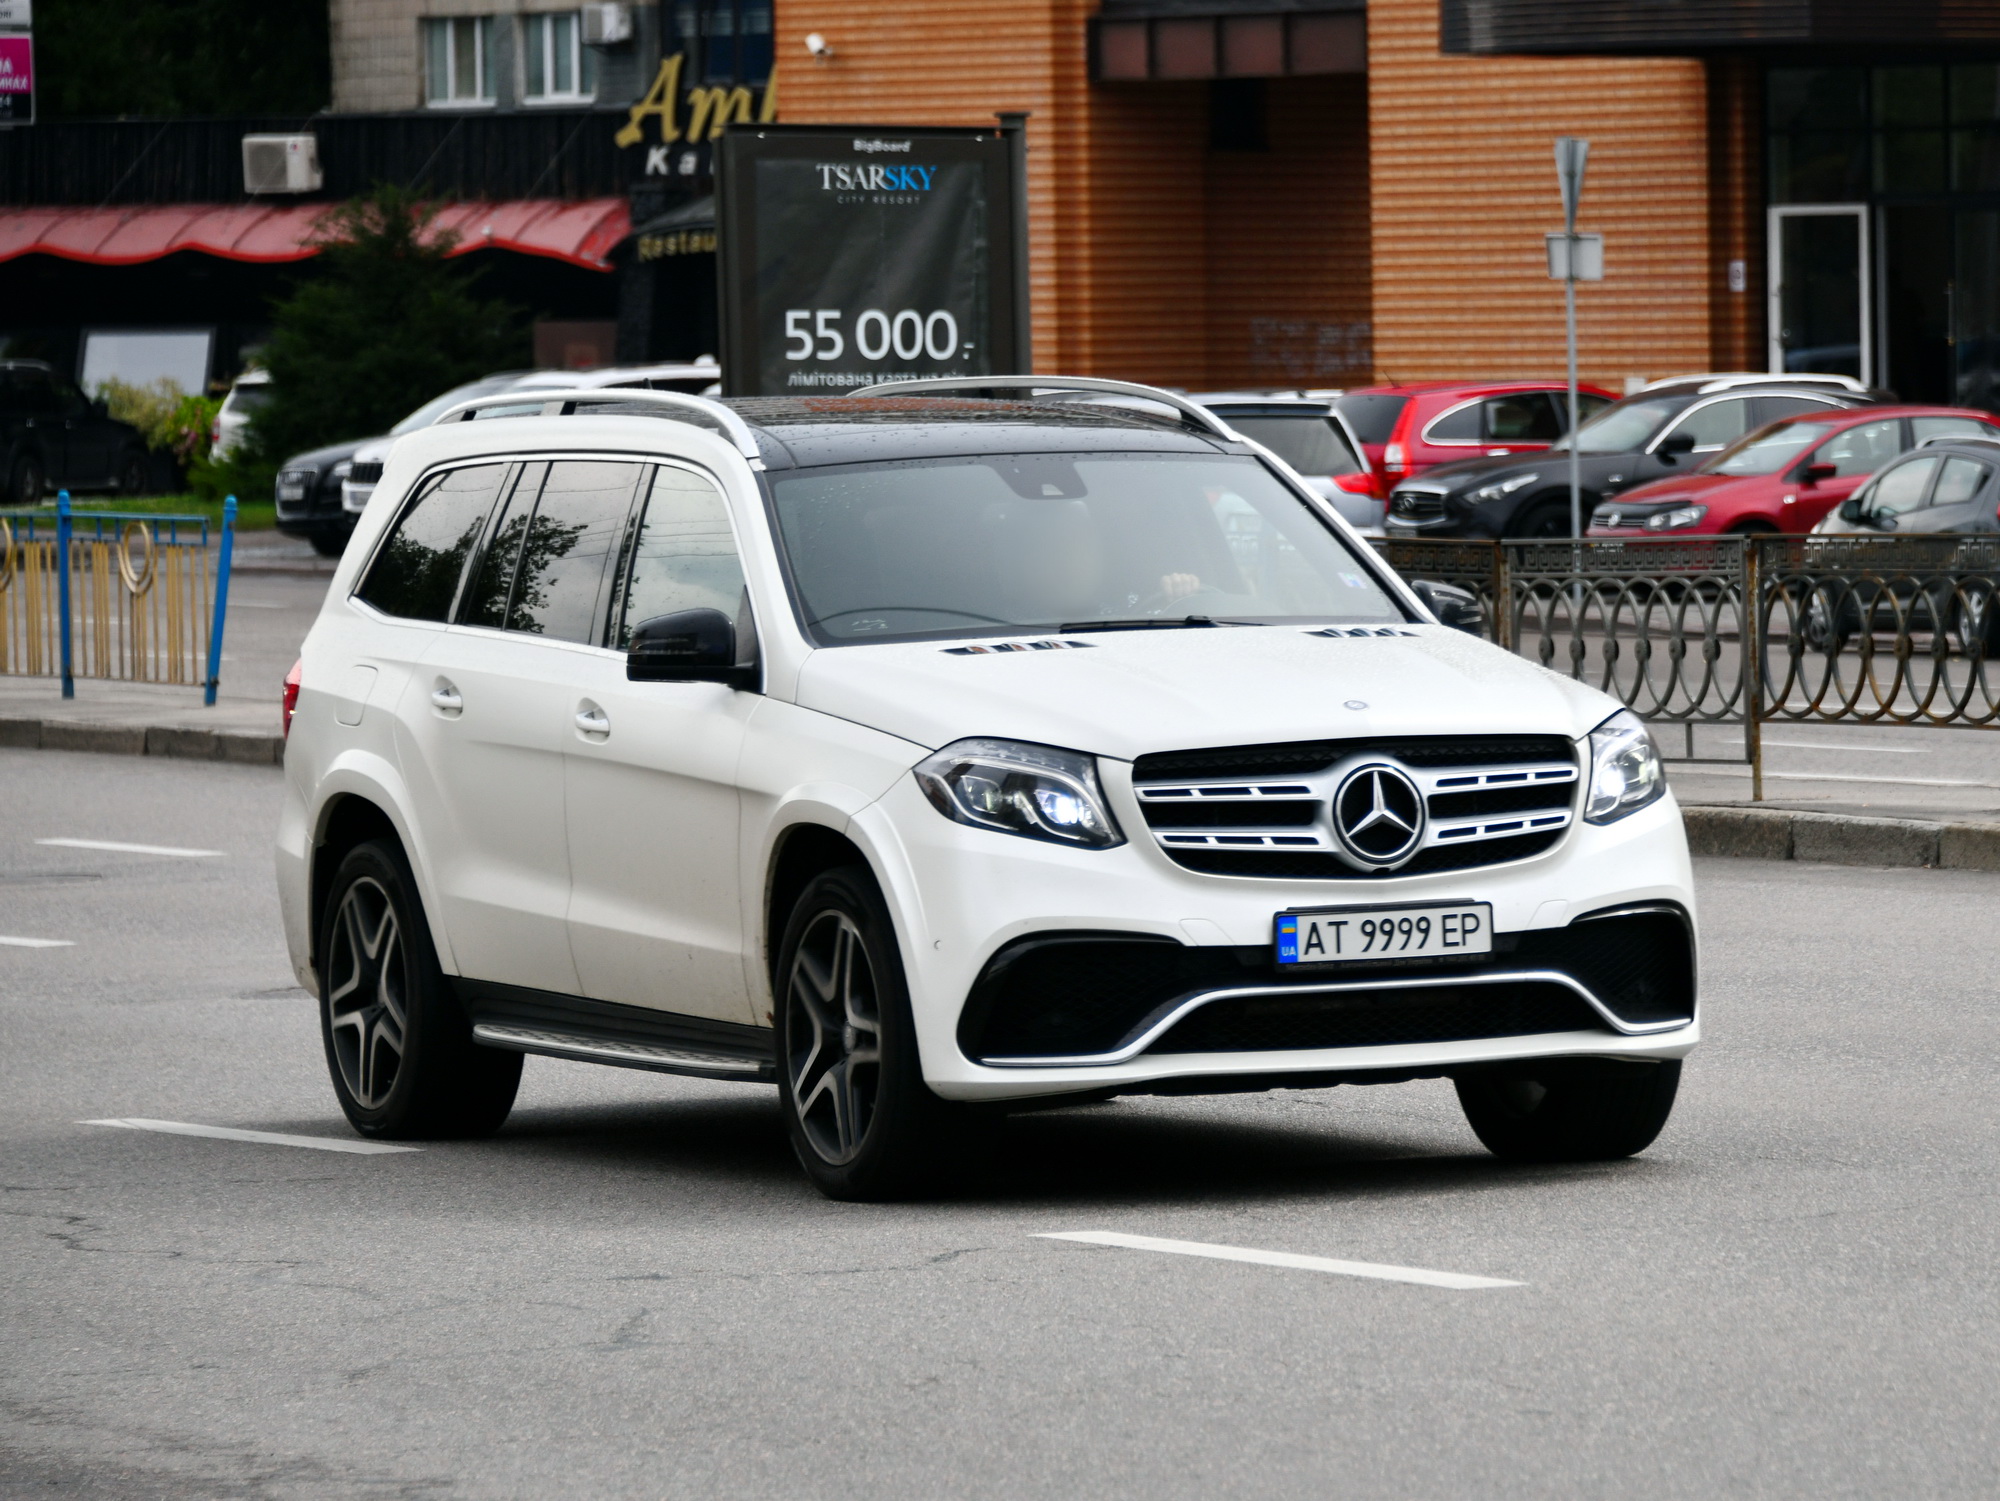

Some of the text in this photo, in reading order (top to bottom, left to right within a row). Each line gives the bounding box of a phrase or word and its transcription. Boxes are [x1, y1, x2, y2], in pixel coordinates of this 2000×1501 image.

[853, 139, 912, 154] BigBoard
[816, 163, 937, 192] TSARSKY
[837, 195, 921, 205] CITY RESORT
[785, 308, 845, 361] 55
[787, 370, 874, 387] лімітована
[1303, 912, 1481, 956] AT 9999 EP
[1281, 946, 1297, 957] UA
